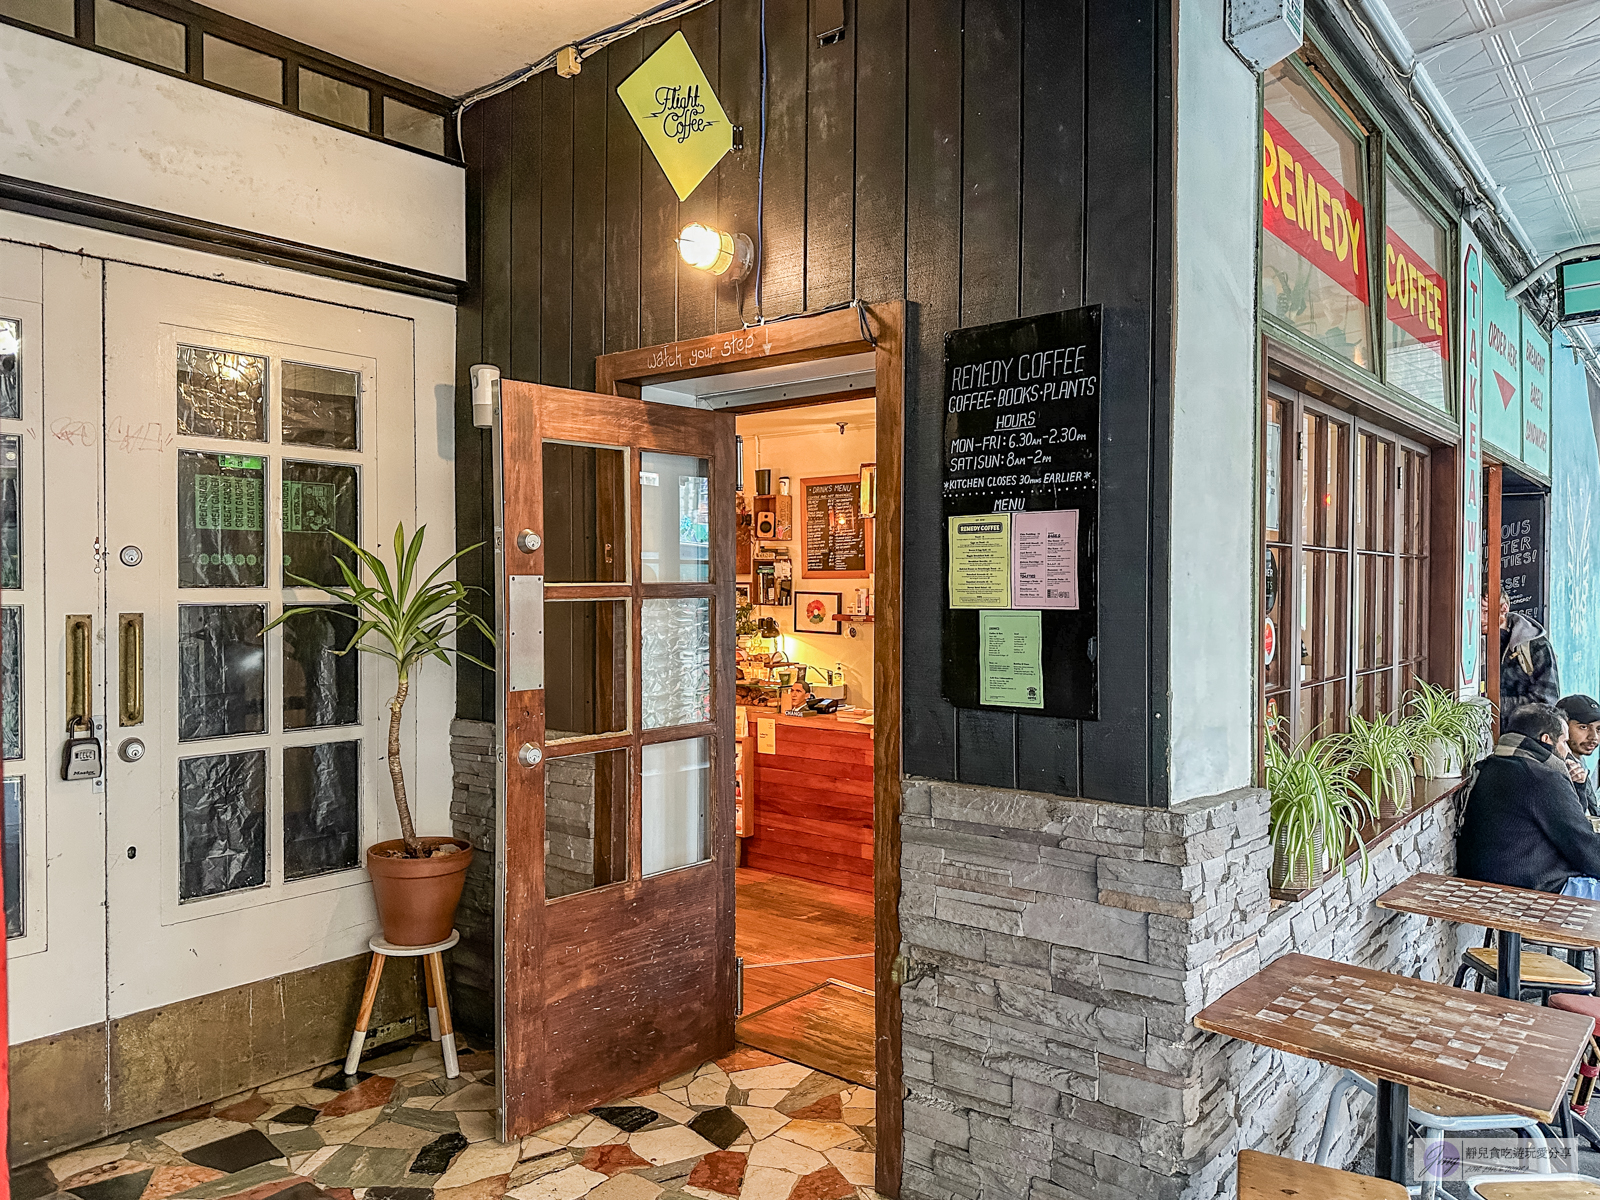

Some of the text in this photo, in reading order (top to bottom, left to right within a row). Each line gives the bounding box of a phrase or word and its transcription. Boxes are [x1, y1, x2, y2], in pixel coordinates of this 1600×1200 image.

[653, 84, 705, 115] Flight
[663, 107, 708, 144] Coffee
[1263, 128, 1443, 337] REMEDY COFFEE
[689, 346, 716, 366] your
[1488, 320, 1507, 360] ORDER
[951, 345, 1087, 392] REMEDY COFFEE
[995, 410, 1036, 430] HOURS
[987, 475, 1017, 487] CLOSES
[1464, 279, 1478, 649] TAKEAWAY
[199, 477, 208, 527] GREAT GARDEN
[223, 479, 232, 528] GREAT GARDEN
[235, 479, 244, 528] GREAT GARDEN
[247, 480, 255, 529] GREAT GARDEN
[833, 484, 852, 492] MENU
[993, 498, 1026, 512] MENU
[1500, 519, 1531, 540] OUS
[1500, 536, 1532, 555] TER
